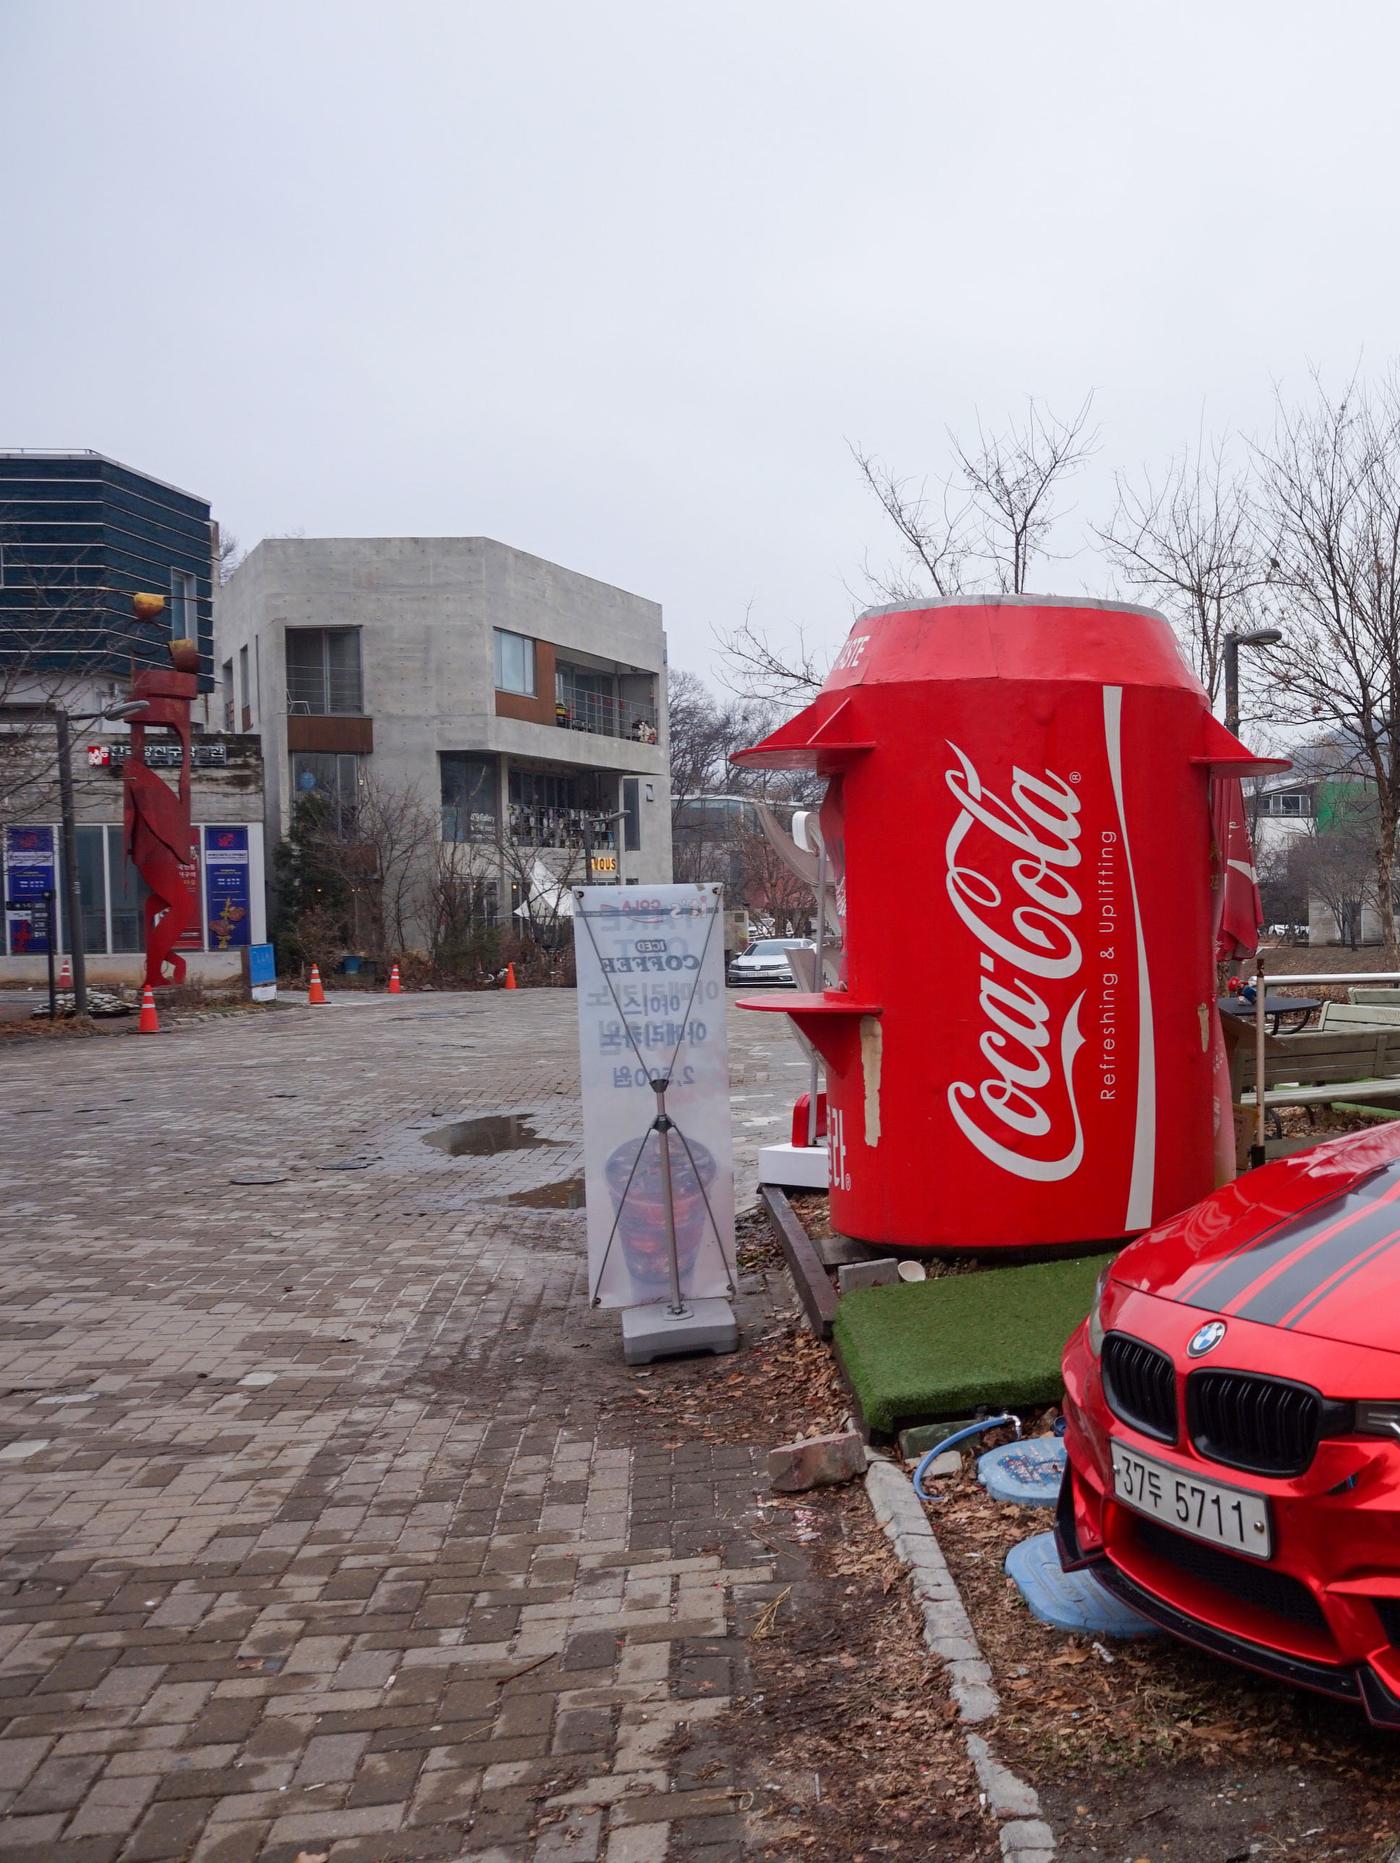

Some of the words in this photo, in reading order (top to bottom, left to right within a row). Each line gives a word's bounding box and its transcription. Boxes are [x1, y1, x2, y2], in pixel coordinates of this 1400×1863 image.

[1098, 831, 1118, 934] Uplifting
[945, 738, 1083, 1182] Coca-Cola
[1099, 946, 1116, 960] &
[1099, 973, 1119, 1100] Refreshing
[1121, 1456, 1163, 1508] 37두
[1175, 1480, 1245, 1543] 5711
